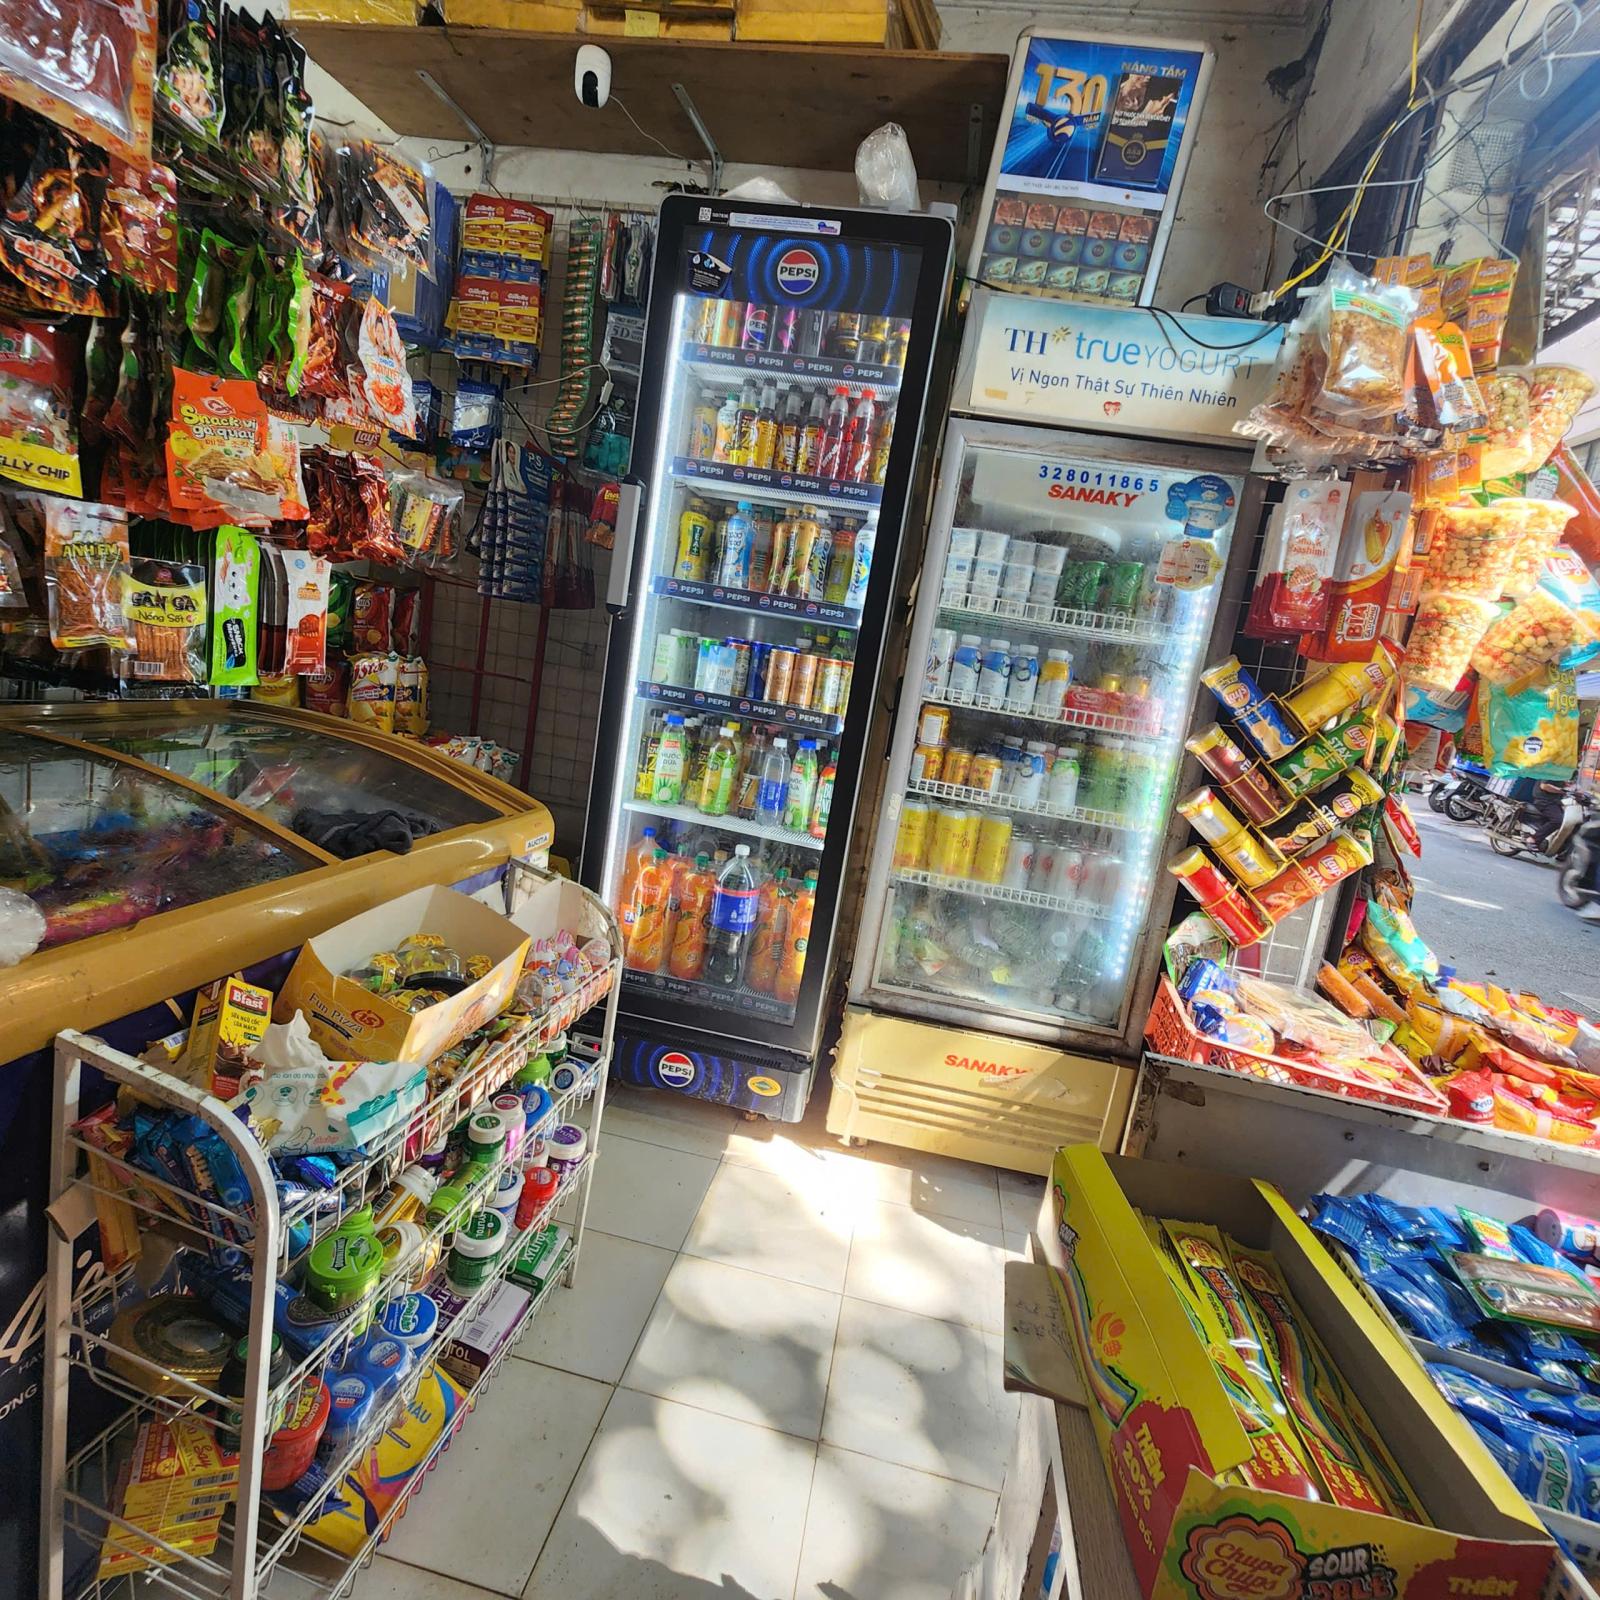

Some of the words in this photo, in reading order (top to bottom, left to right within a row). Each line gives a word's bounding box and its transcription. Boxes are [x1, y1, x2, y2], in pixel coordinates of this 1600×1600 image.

[780, 266, 816, 279] PEPSI
[1004, 327, 1049, 356] TH
[710, 351, 736, 362] PEPSI
[758, 357, 784, 368] PEPSI
[807, 363, 833, 374] PEPSI
[857, 369, 883, 379] PEPSI
[1010, 367, 1024, 385] Vị
[1028, 370, 1069, 389] Ngon
[1076, 375, 1108, 396] Thật
[1113, 380, 1136, 396] Sự
[1140, 383, 1183, 402] Thiên
[1189, 388, 1237, 408] Nhiên
[179, 404, 240, 427] Snack
[353, 430, 381, 446] Lay's
[37, 464, 70, 481] CHIP
[700, 465, 725, 476] PEPSI
[747, 472, 772, 483] PEPSI
[795, 479, 820, 490] PEPSI
[843, 486, 869, 497] PEPSI
[1047, 484, 1139, 508] SANAKY
[680, 585, 705, 596] PEPSI
[726, 592, 751, 603] PEPSI
[773, 599, 798, 610] PEPSI
[819, 607, 845, 619] PEPSI
[662, 688, 687, 700] PEPSI
[707, 696, 732, 708] PEPSI
[752, 704, 777, 717] PEPSI
[798, 713, 824, 725] PEPSI
[1328, 736, 1353, 760] STAX
[625, 973, 648, 984] PEPSI
[668, 982, 691, 993] PEPSI
[233, 989, 264, 1010] Bfast
[711, 991, 735, 1003] PEPSI
[309, 992, 328, 1014] Fun
[331, 1010, 364, 1034] Pizza
[755, 1001, 779, 1013] PEPSI
[661, 1063, 693, 1077] PEPSI
[1134, 1422, 1166, 1489] THÊM
[1123, 1440, 1153, 1511] 20%
[1214, 1542, 1288, 1575] Chupa
[1308, 1547, 1370, 1578] SOUR
[1205, 1558, 1278, 1595] Chups
